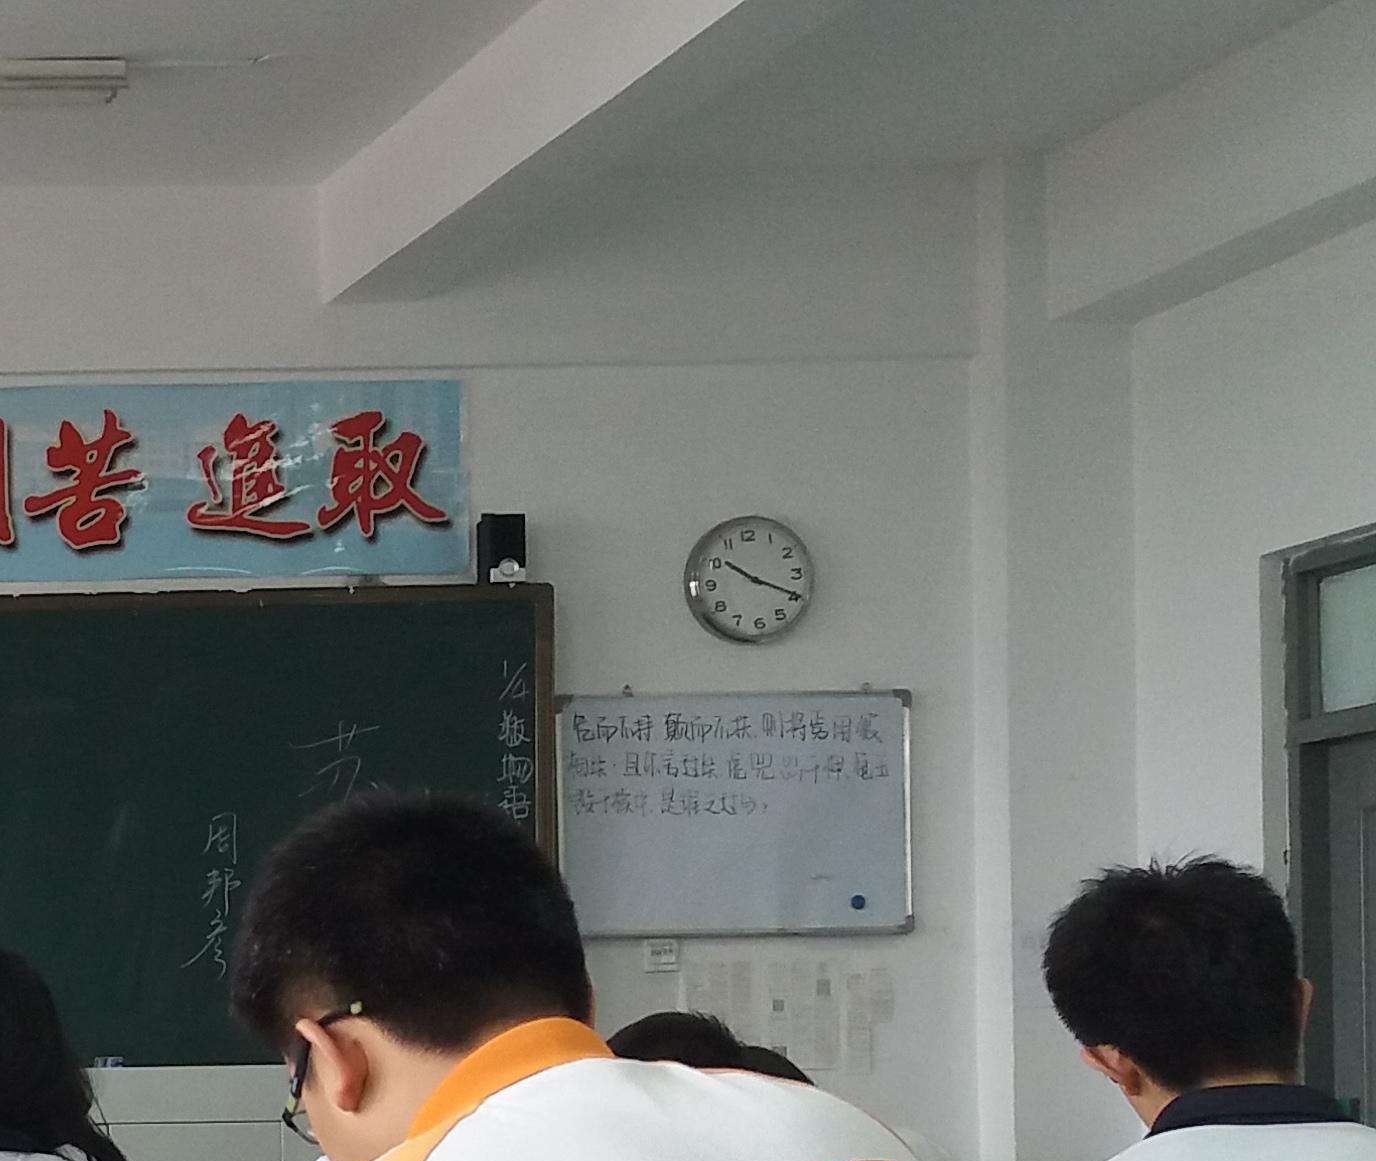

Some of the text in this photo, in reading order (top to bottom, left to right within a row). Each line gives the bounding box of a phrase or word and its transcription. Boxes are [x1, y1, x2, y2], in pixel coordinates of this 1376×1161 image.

[741, 530, 756, 542] 12
[768, 532, 773, 544] 1
[724, 538, 733, 550] 11
[782, 547, 794, 559] 2
[791, 567, 803, 580] 3
[705, 579, 717, 592] 9
[714, 600, 727, 612] 8
[732, 614, 742, 627] 7
[775, 609, 787, 621] 5
[753, 617, 766, 630] 6
[180, 812, 242, 980] 周邦彦
